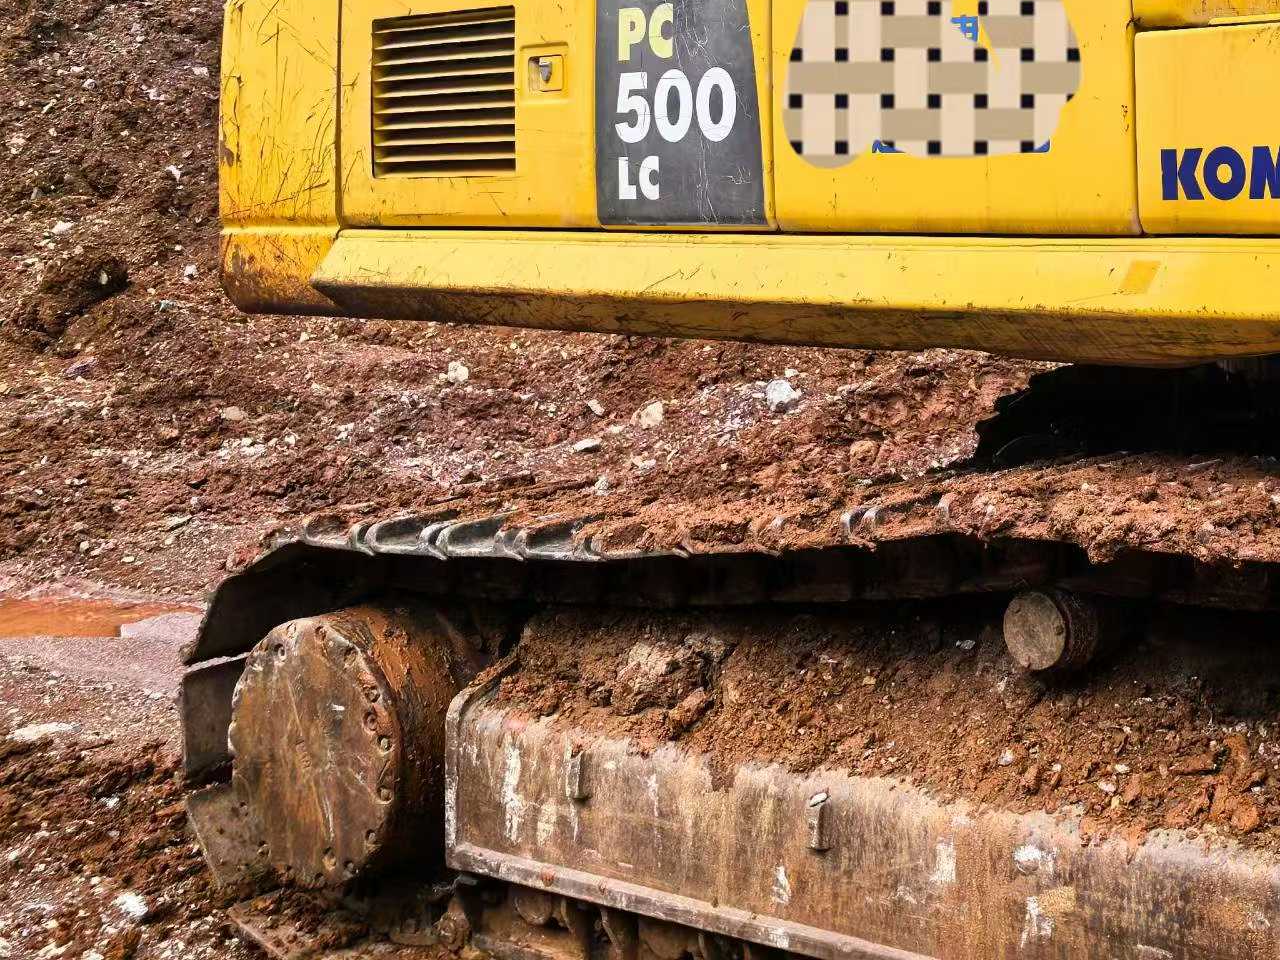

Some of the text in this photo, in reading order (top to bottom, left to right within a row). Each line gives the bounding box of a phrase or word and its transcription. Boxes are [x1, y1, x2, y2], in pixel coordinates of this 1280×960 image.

[617, 2, 674, 62] PC
[614, 66, 737, 144] 500
[618, 155, 660, 201] LC
